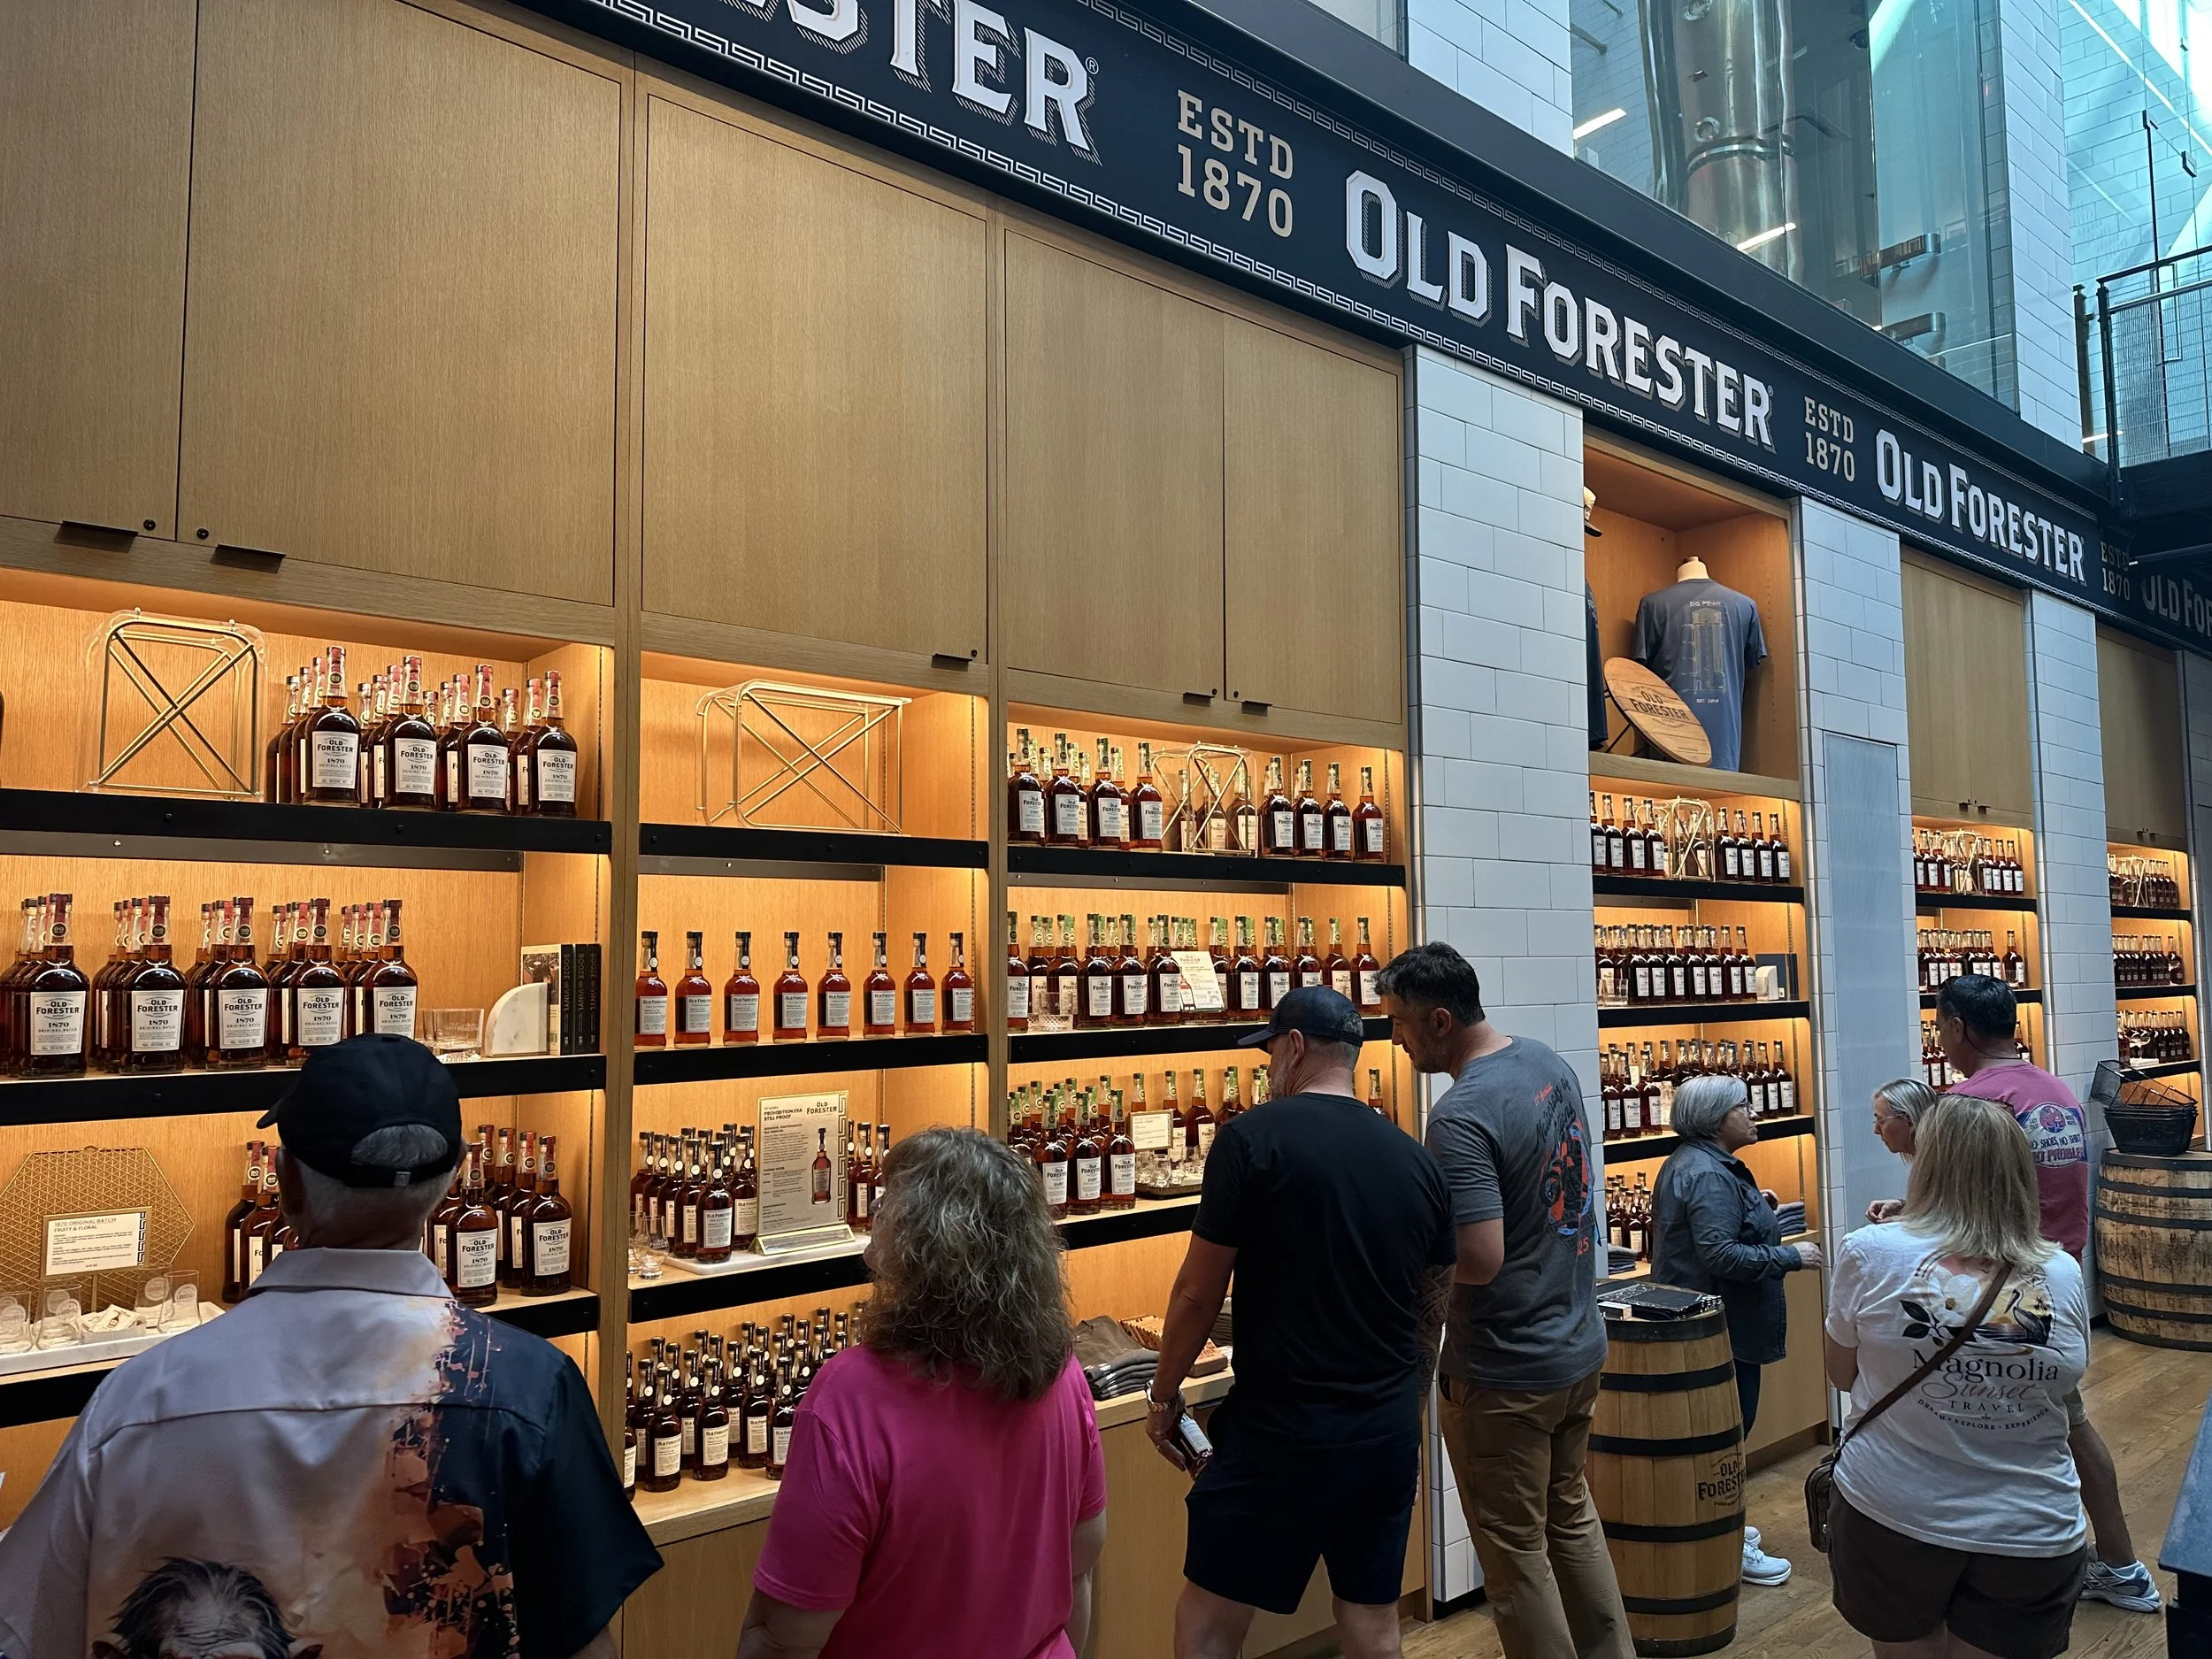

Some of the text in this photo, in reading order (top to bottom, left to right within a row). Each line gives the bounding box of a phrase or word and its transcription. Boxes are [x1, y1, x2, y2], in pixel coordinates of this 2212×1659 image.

[1178, 89, 1294, 180] ESTD
[1178, 144, 1294, 238] 1870
[1345, 170, 1775, 454] OLD FORESTER
[1804, 396, 1854, 443] ESTD
[1805, 432, 1855, 482] 1870
[1876, 429, 2086, 587] OLD FORESTER
[2102, 567, 2130, 601] 1870
[1629, 698, 1689, 720] FORESTER
[1641, 691, 1663, 703] OLD
[2059, 1137, 2068, 1146] NO
[462, 1243, 494, 1252] FORESTER
[539, 1233, 568, 1241] FORESTER
[1912, 1348, 2058, 1383] Magnolia
[1922, 1371, 2047, 1400] Sunset
[1948, 1400, 2024, 1413] TRAVEL
[1955, 1419, 1995, 1430] EXPLORE
[2005, 1408, 2049, 1429] EXPERIENCE
[1720, 1461, 1737, 1477] OLD
[1698, 1470, 1746, 1501] FORESTE
